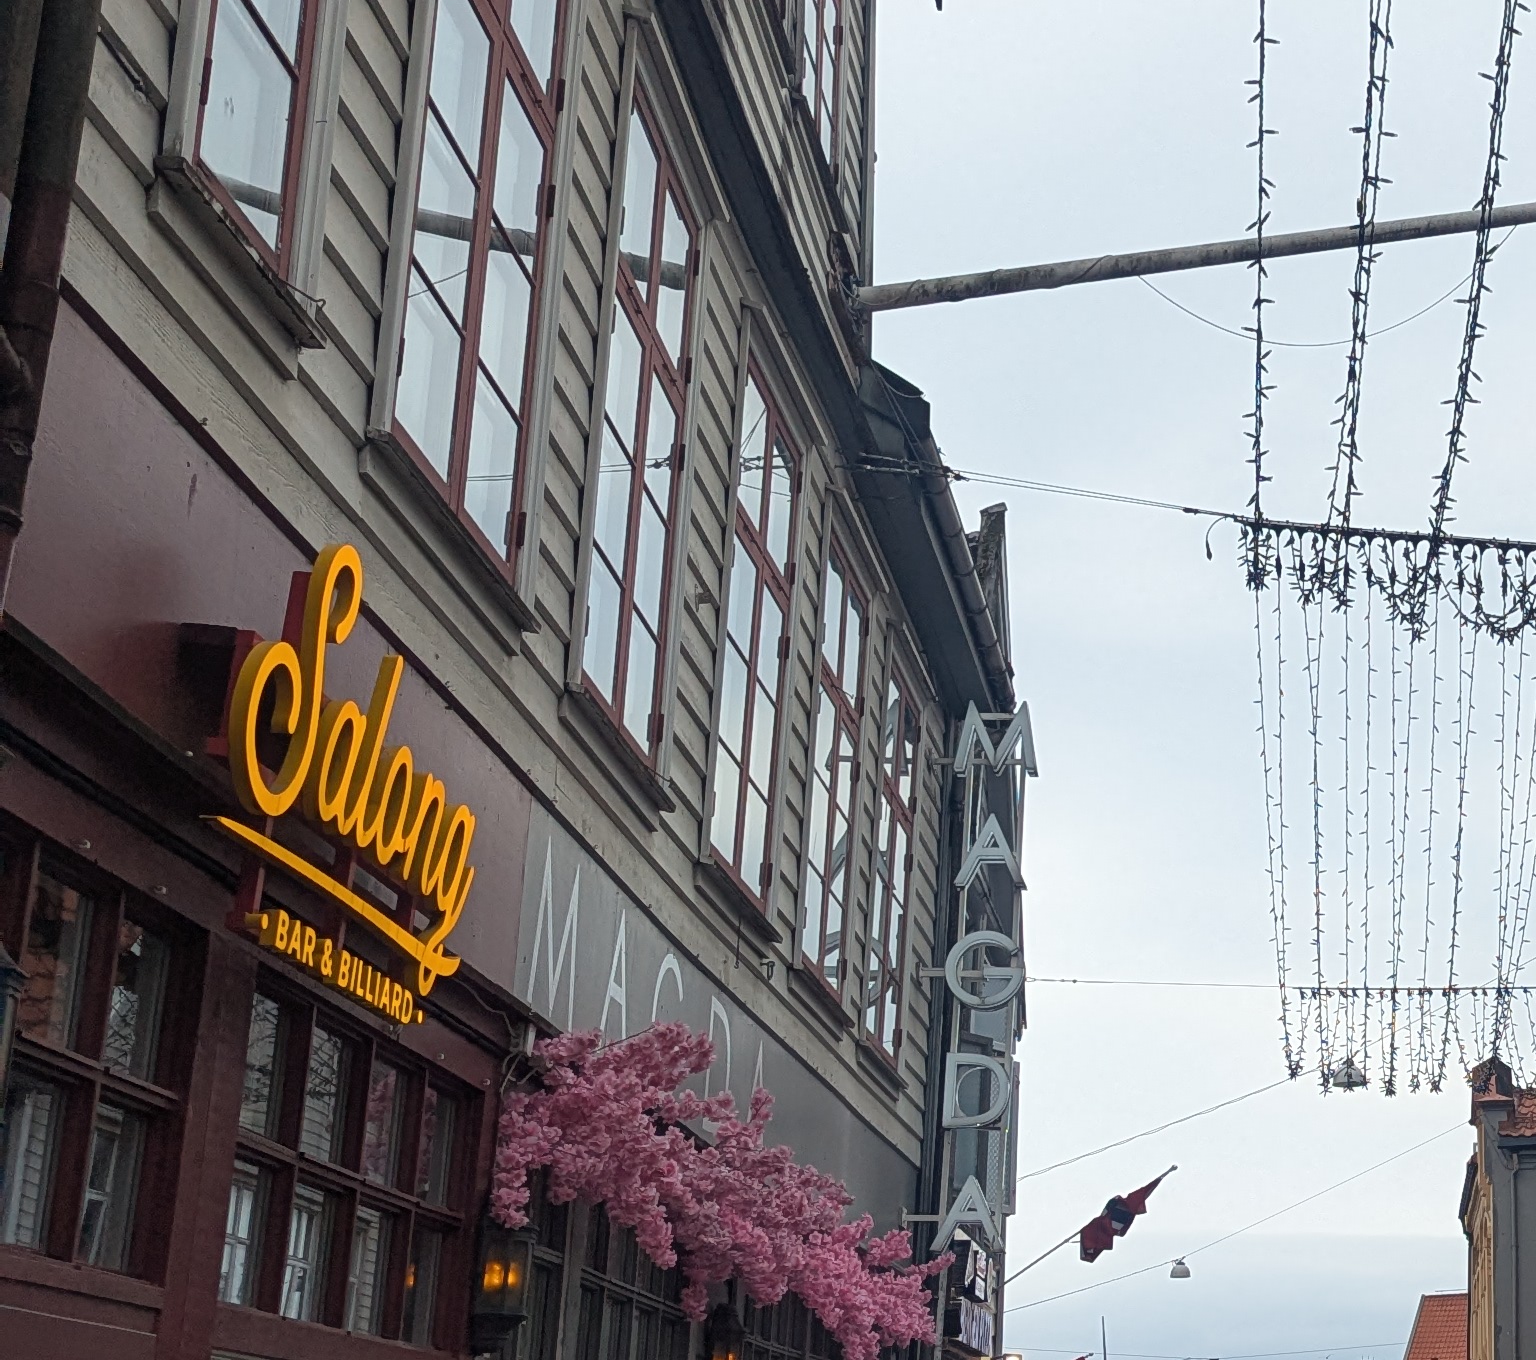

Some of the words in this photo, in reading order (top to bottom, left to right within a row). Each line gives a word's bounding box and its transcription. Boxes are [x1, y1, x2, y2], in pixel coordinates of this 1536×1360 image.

[232, 544, 477, 996] Salong
[275, 907, 315, 968] BAR
[320, 939, 333, 977] &
[338, 950, 414, 1025] BILLIARD
[930, 700, 1038, 1255] MAGDA
